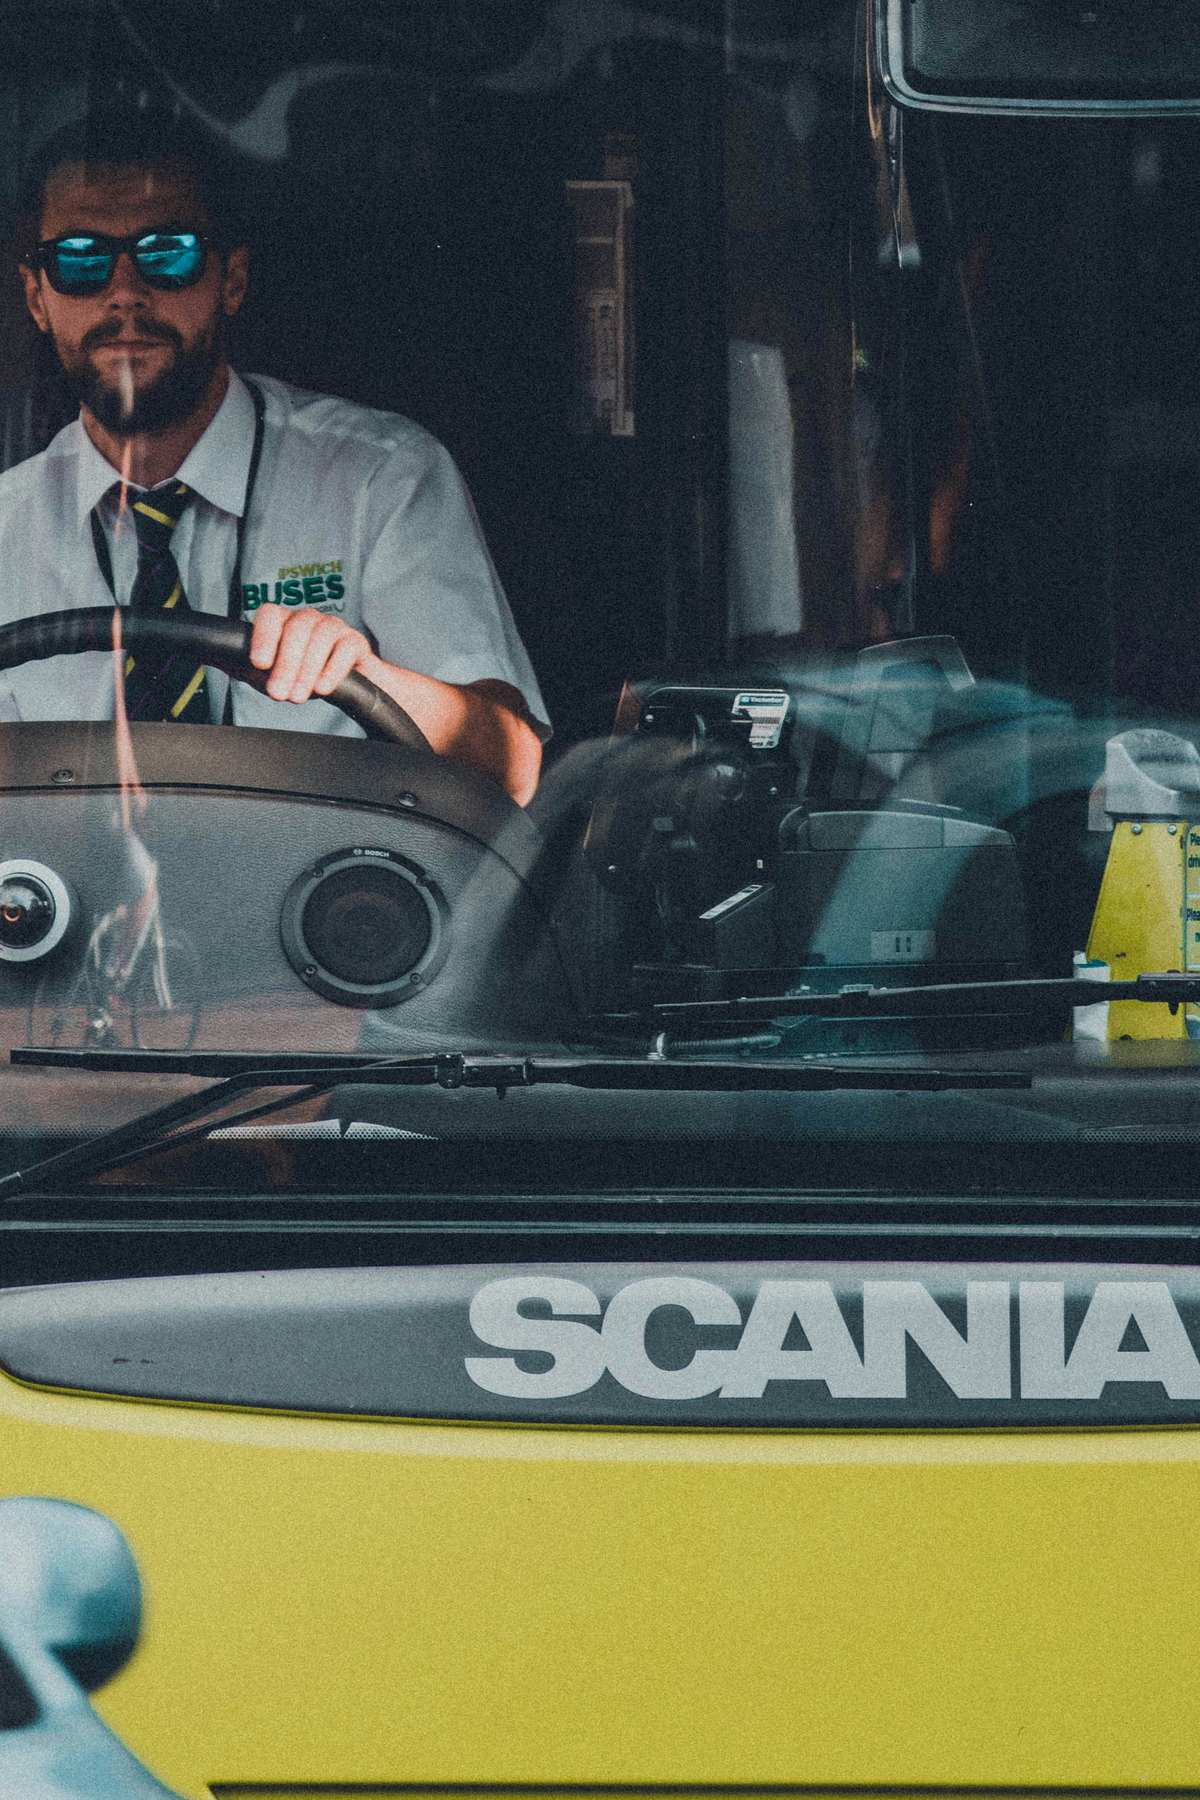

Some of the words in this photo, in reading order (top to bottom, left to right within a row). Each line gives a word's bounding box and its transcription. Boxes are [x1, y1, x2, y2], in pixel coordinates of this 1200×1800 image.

[278, 559, 342, 579] IPSWICH
[242, 574, 345, 611] BUSES
[365, 849, 390, 858] BOSCH
[464, 1276, 1200, 1400] SCANIA
